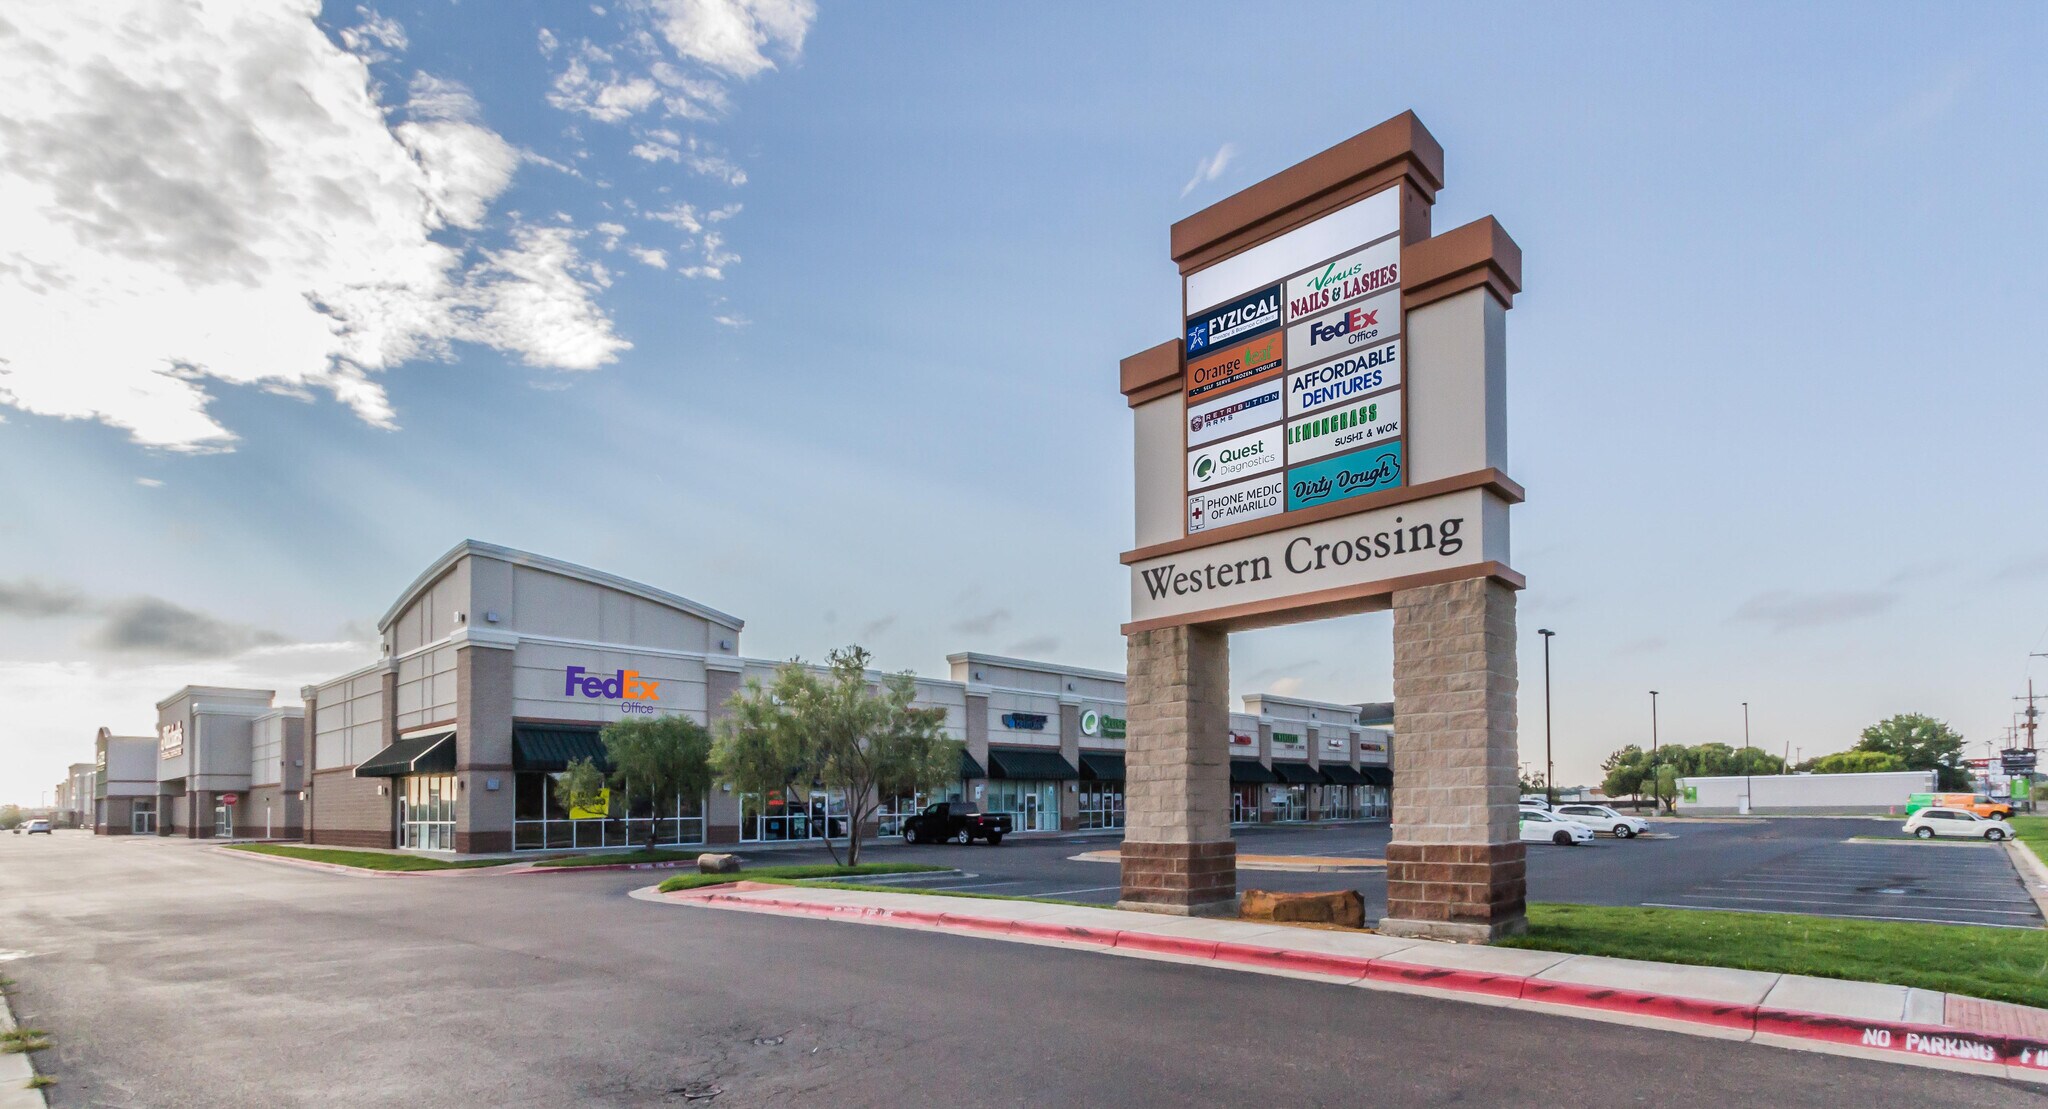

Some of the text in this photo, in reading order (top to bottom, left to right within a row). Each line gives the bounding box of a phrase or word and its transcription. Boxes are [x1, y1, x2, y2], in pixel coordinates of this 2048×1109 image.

[1290, 264, 1397, 319] NAILS & LASHES
[1307, 263, 1363, 291] Venus
[1209, 295, 1278, 334] FYZICAL
[1310, 308, 1379, 346] FedEx
[1348, 328, 1378, 345] Office
[1194, 338, 1275, 384] Orange leaf
[1203, 362, 1277, 392] SELF SERVE FROZEN YOGURT
[1292, 345, 1396, 393] AFFORDABLE
[1302, 370, 1383, 408] DENTURES
[1205, 393, 1278, 421] RETRIBUTION
[1288, 403, 1377, 445] LEMONGRASS
[1334, 422, 1399, 447] SUSHI & WOK
[1219, 440, 1264, 465] Quest
[1220, 453, 1276, 476] Diagnostics
[1207, 483, 1282, 511] PHONE MEDIC
[1293, 460, 1390, 503] Dirty Dough
[1211, 496, 1277, 520] OF AMARILLO
[1142, 516, 1464, 601] Western Crossing
[565, 665, 660, 701] FedEx
[621, 701, 654, 714] Office
[1862, 1028, 1892, 1048] NO
[1905, 1032, 1994, 1062] PARKING
